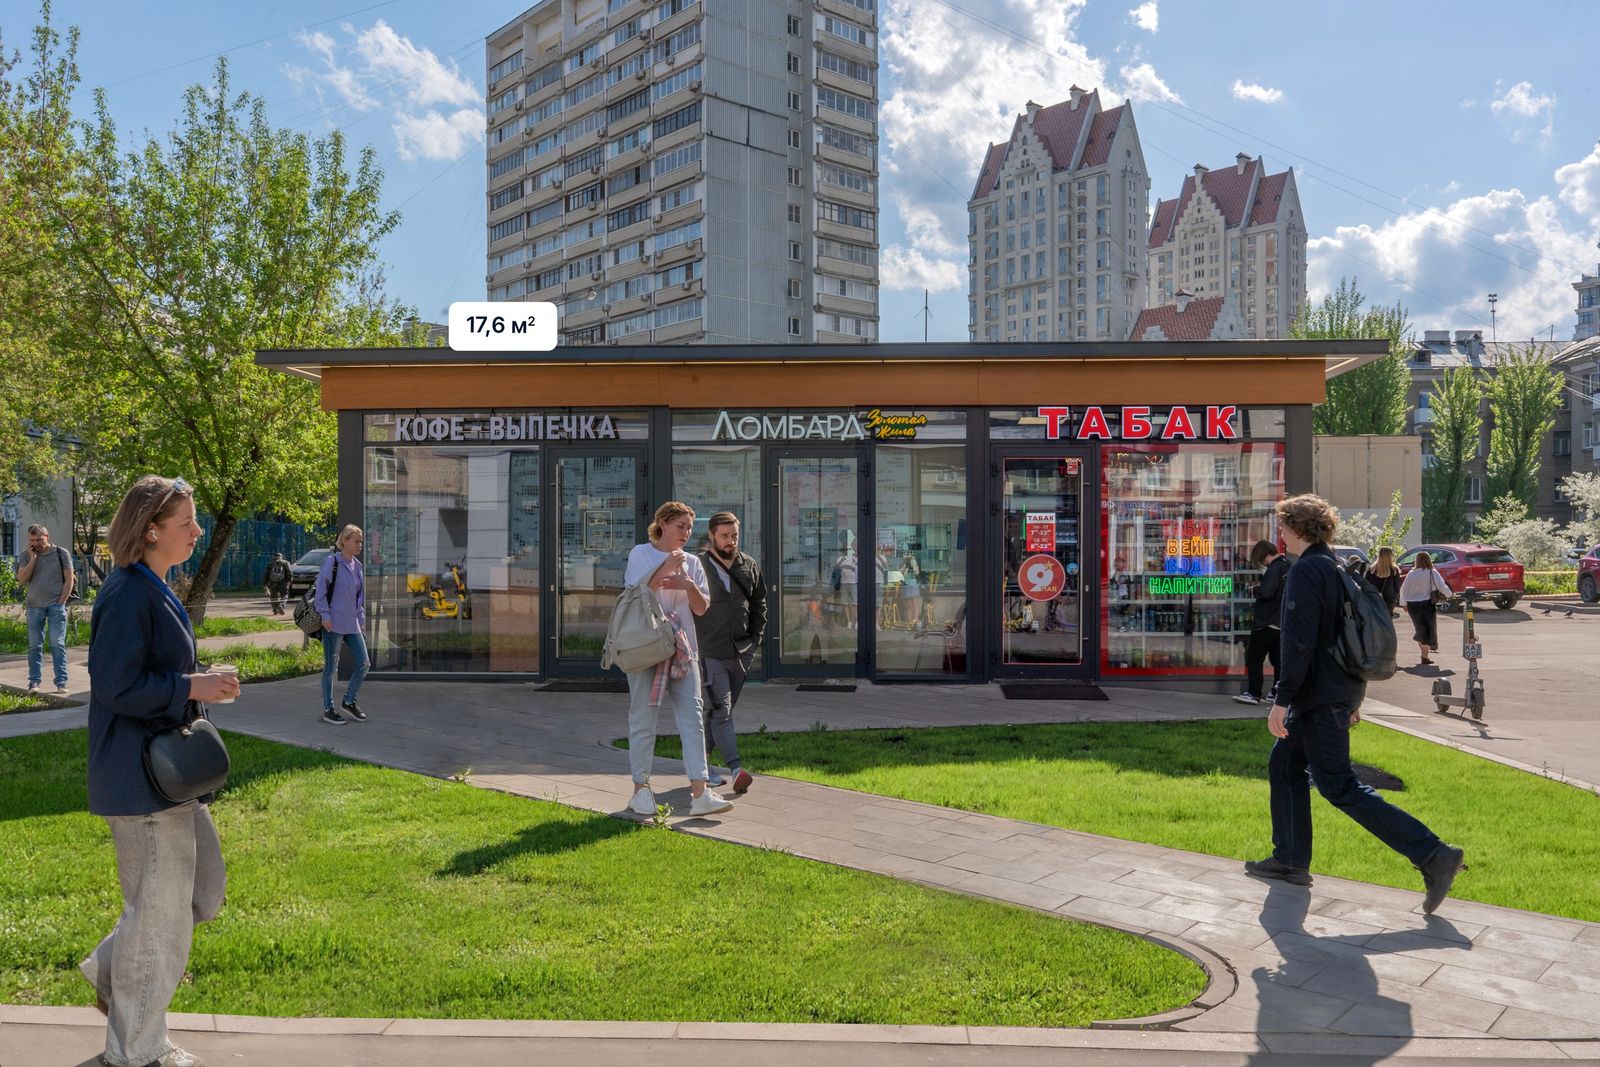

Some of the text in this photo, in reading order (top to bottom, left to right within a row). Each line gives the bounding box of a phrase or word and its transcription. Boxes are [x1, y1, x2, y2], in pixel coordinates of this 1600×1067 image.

[395, 417, 464, 441] КОФЕ
[490, 415, 616, 440] ВЫПЕЧКА
[711, 411, 864, 440] ЛОМБАРД
[865, 409, 927, 428] Золотая
[1037, 406, 1237, 439] ТАБАК
[876, 425, 916, 438] Жила
[1167, 536, 1214, 555] ВЕЙП
[1165, 557, 1216, 576] ВОДА
[1149, 577, 1232, 594] НАПИТКИ
